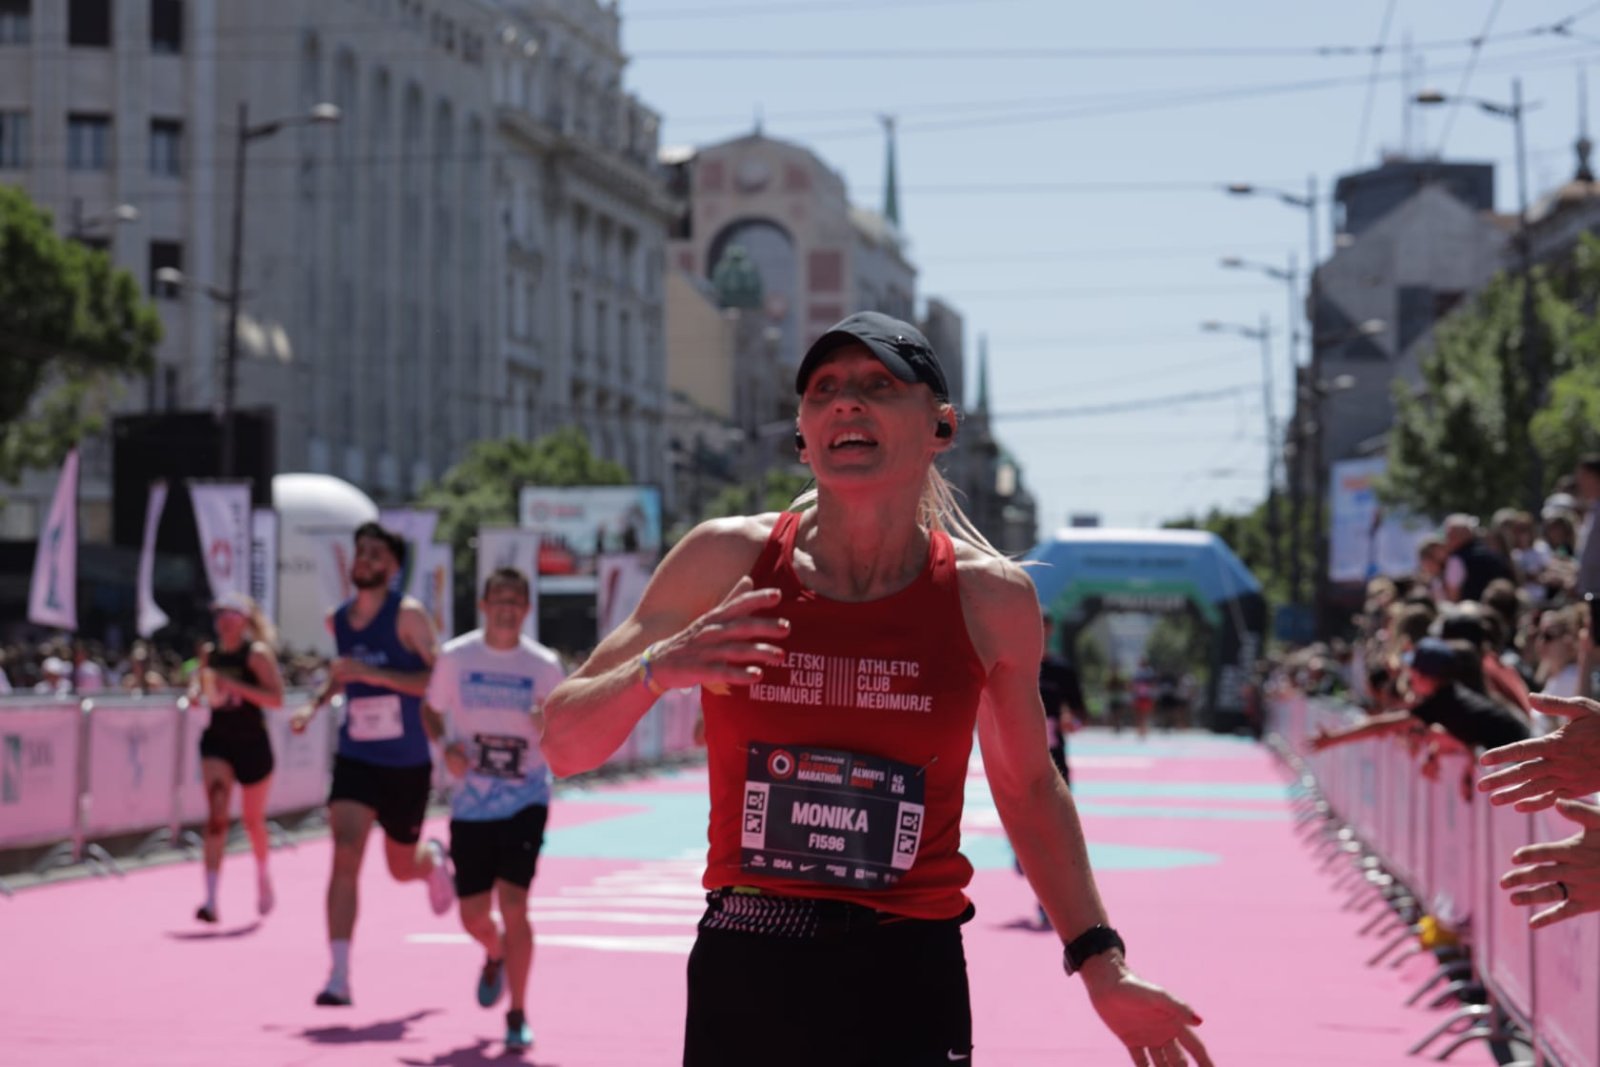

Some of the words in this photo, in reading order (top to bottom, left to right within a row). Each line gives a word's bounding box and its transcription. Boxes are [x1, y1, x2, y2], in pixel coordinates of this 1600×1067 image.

[765, 652, 825, 671] LETSKI
[857, 658, 920, 677] ATHLETIC
[789, 670, 824, 687] KLUB
[857, 676, 891, 691] CLUB
[749, 685, 823, 706] MEĐIMURJE
[856, 693, 933, 712] MEĐIMURJE
[797, 770, 843, 785] MARATHON
[851, 767, 885, 782] ALWAYS
[892, 774, 904, 784] 42
[891, 784, 905, 795] KM
[791, 801, 869, 833] MONIKA
[808, 832, 846, 852] F1596
